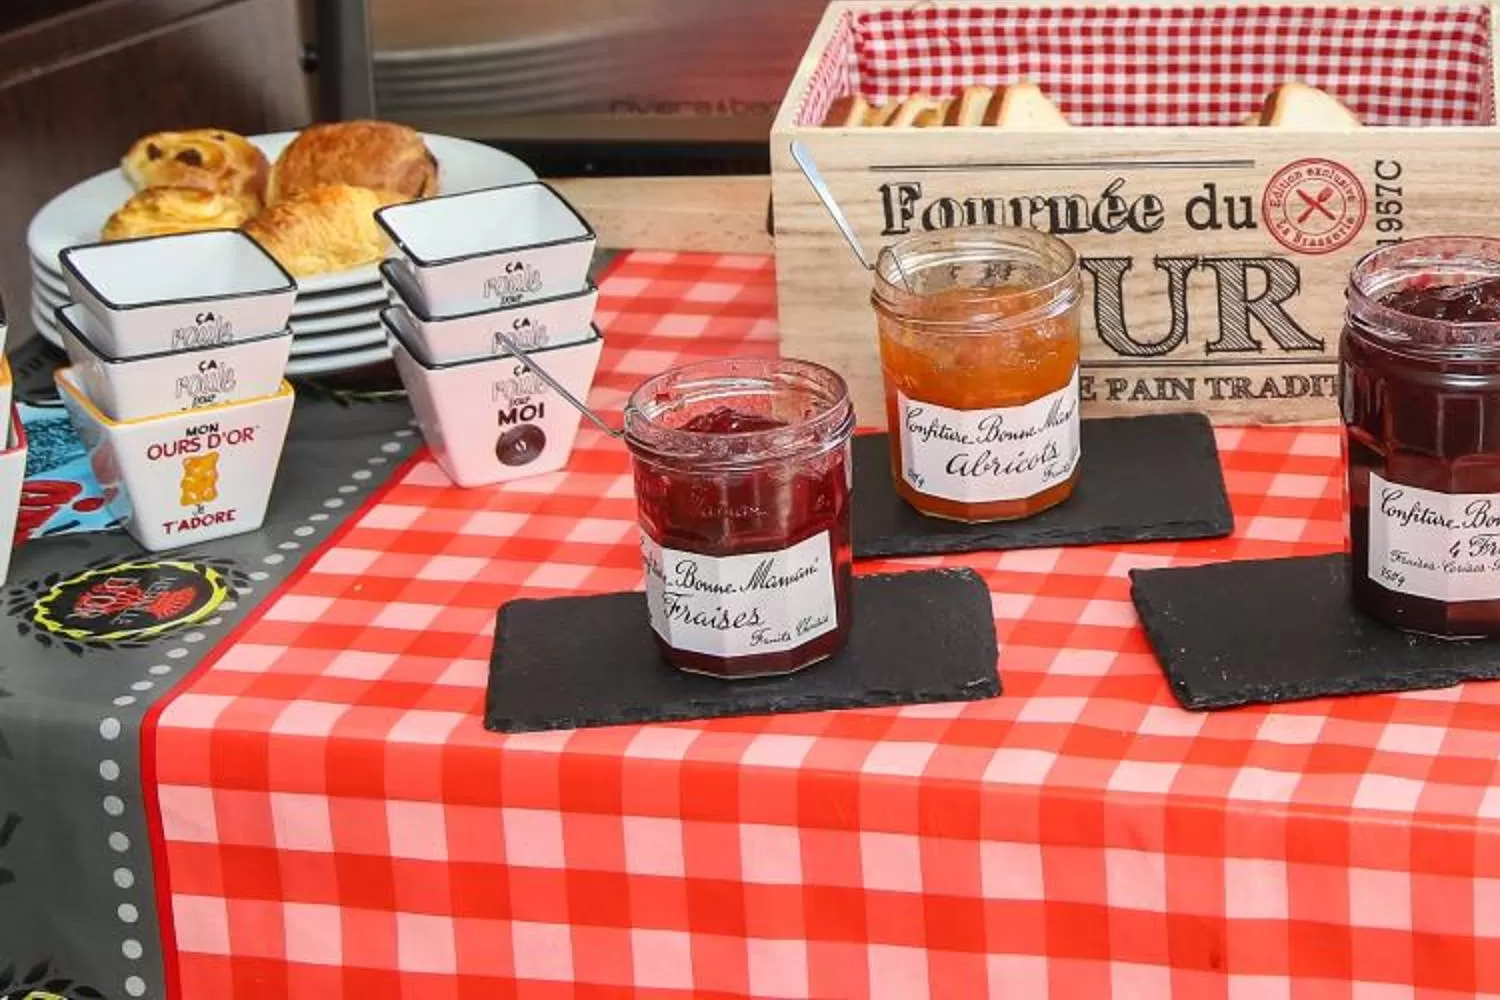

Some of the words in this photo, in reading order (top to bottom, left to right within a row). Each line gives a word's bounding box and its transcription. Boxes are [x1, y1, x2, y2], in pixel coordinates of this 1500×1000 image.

[880, 177, 1165, 237] Fournée
[1185, 183, 1258, 230] du
[1080, 255, 1326, 357] UR
[1105, 376, 1196, 402] PAIN
[1204, 374, 1338, 400] TRADIT
[185, 422, 219, 437] MON
[498, 402, 545, 427] MOI
[146, 436, 202, 461] OURS
[206, 426, 255, 449] D'OR
[163, 508, 236, 534] T'ADORE
[675, 559, 738, 595] Bonne
